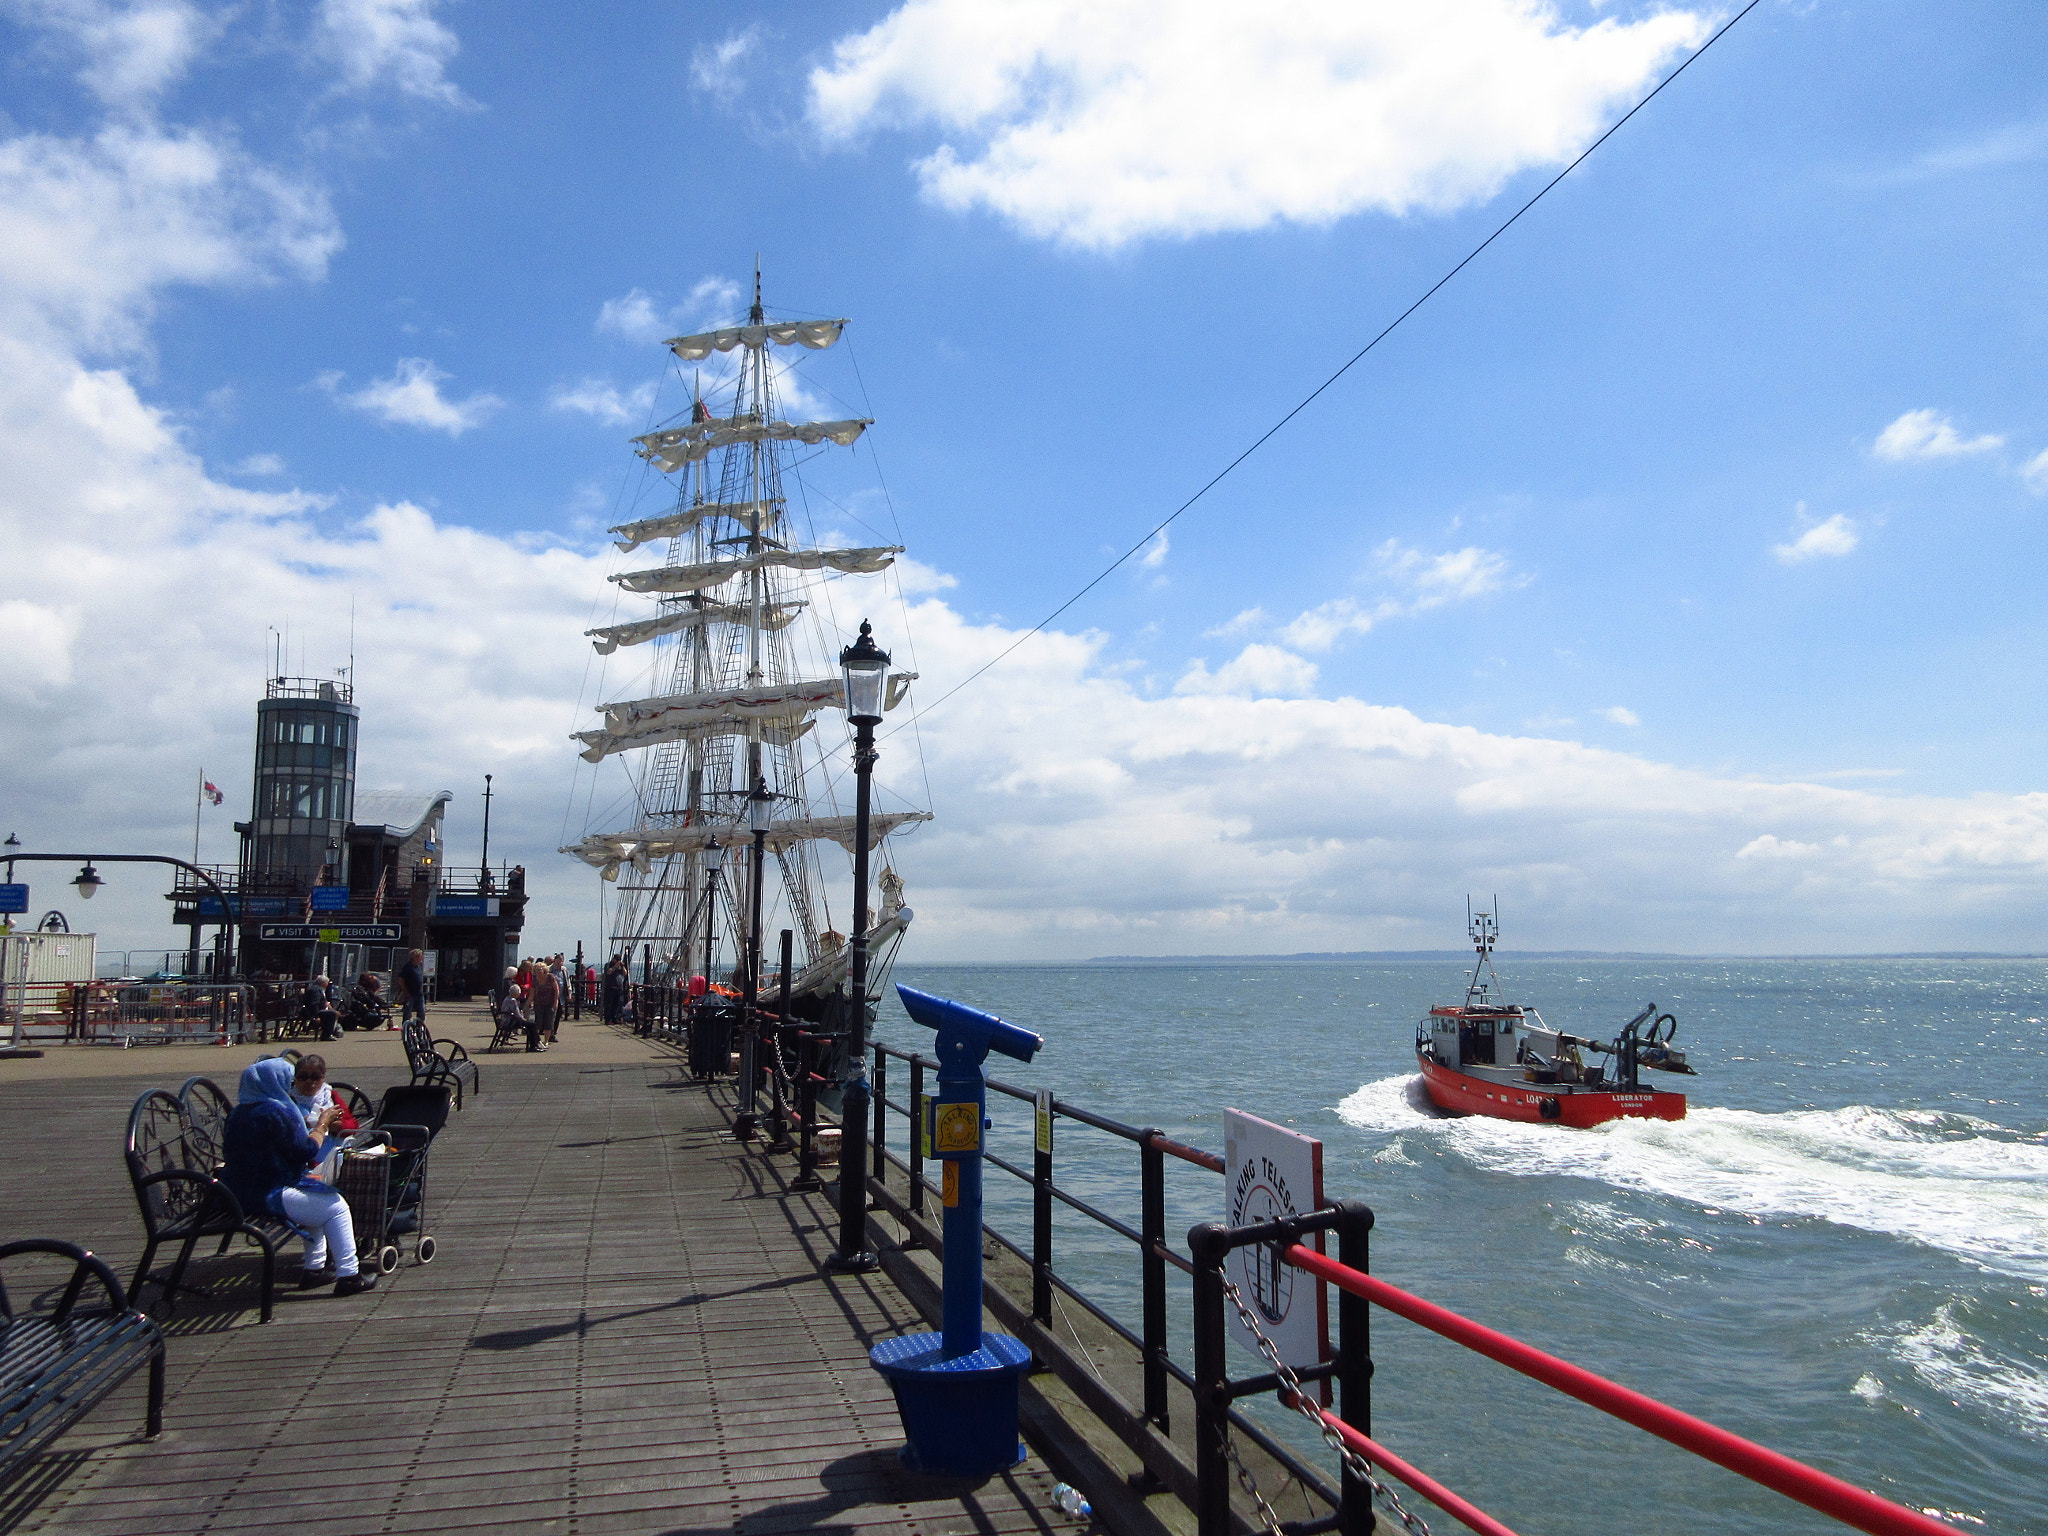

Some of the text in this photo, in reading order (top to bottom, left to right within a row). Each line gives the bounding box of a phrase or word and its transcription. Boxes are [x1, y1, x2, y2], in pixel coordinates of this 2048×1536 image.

[279, 927, 383, 936] VISIT TH FEBOATS
[943, 1110, 975, 1126] TALKING
